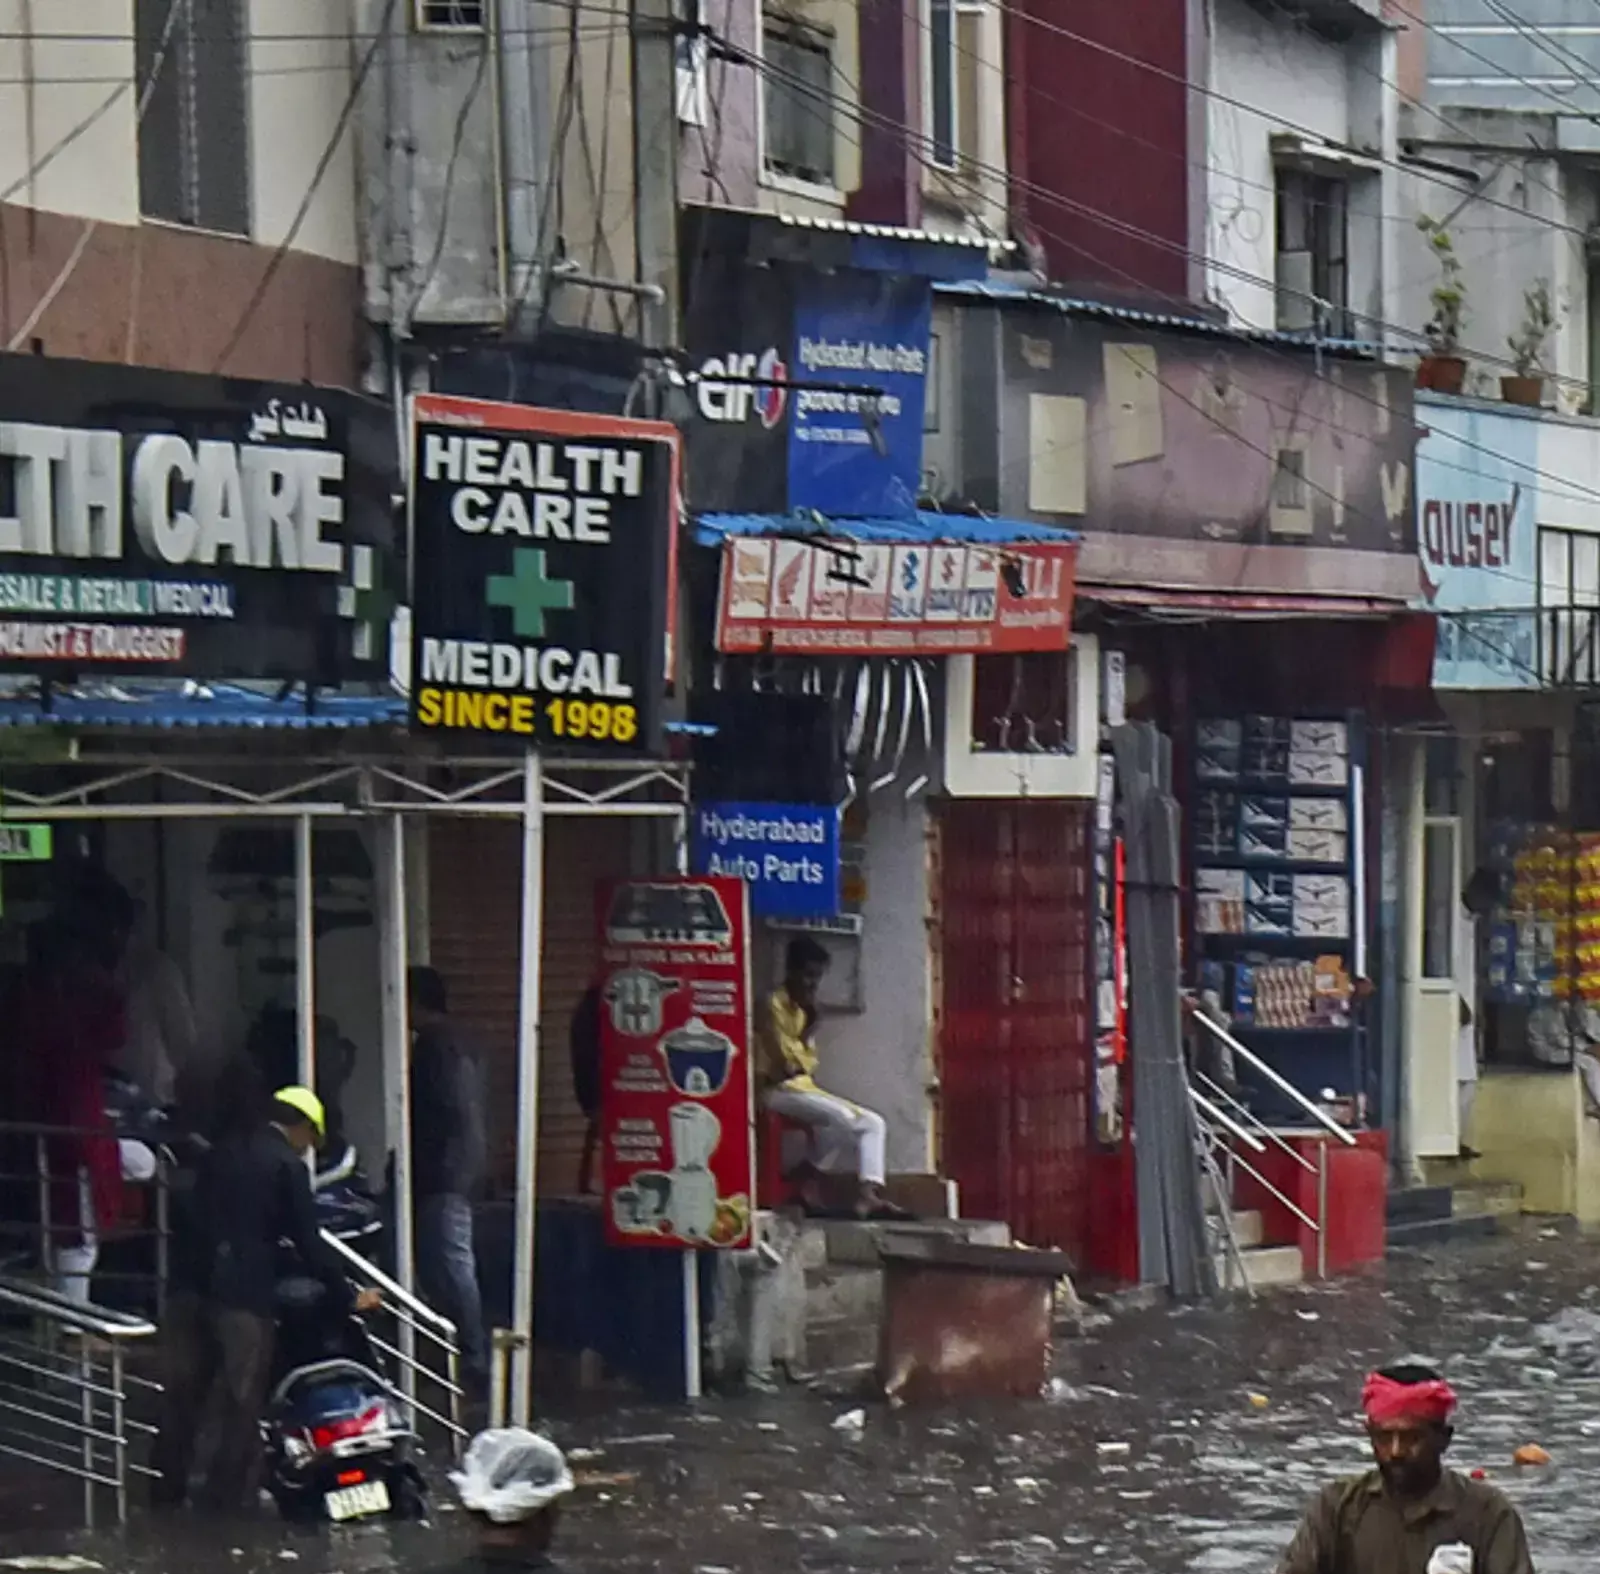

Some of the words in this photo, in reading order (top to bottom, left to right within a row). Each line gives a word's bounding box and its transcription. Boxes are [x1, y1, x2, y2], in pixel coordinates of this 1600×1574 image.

[424, 434, 642, 495] HEALTH
[132, 432, 344, 571] CARE
[452, 487, 611, 542] CARE
[422, 638, 632, 696] MEDICAL
[418, 689, 535, 733] SINCE
[546, 699, 636, 741] 1998
[701, 812, 825, 845] Hyderabad
[708, 852, 760, 881] Auto
[764, 854, 824, 883] Parts
